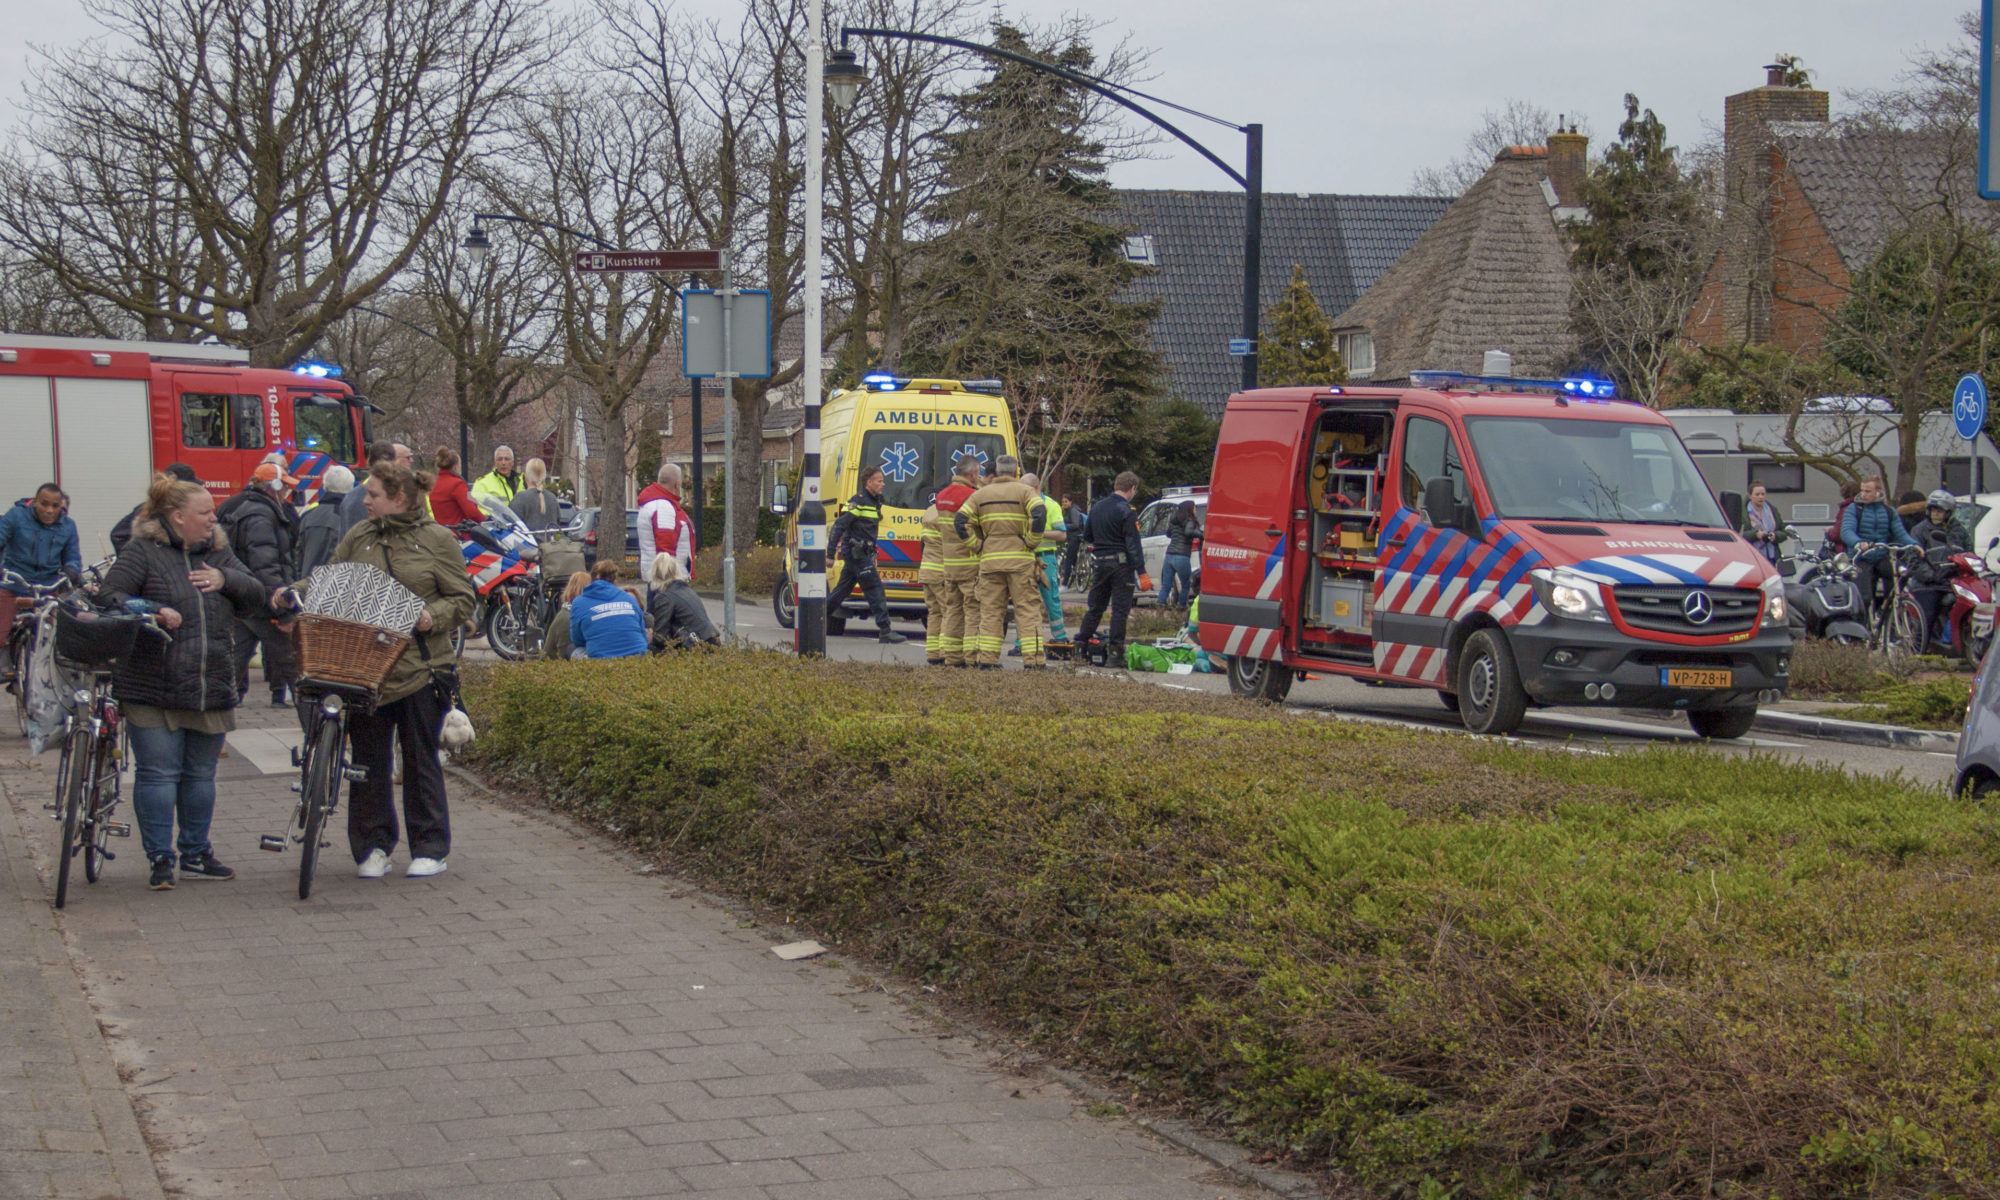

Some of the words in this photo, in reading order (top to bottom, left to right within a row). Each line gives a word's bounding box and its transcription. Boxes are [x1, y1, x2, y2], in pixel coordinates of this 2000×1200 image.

[606, 257, 661, 267] Kunstkerk
[268, 386, 281, 445] 10-4831
[874, 411, 998, 428] AMBULANCE
[203, 481, 231, 489] DWEER
[1604, 541, 1719, 552] BRANDWEER
[1207, 547, 1248, 559] BRANDWEER
[1673, 672, 1727, 685] VP-728-H
